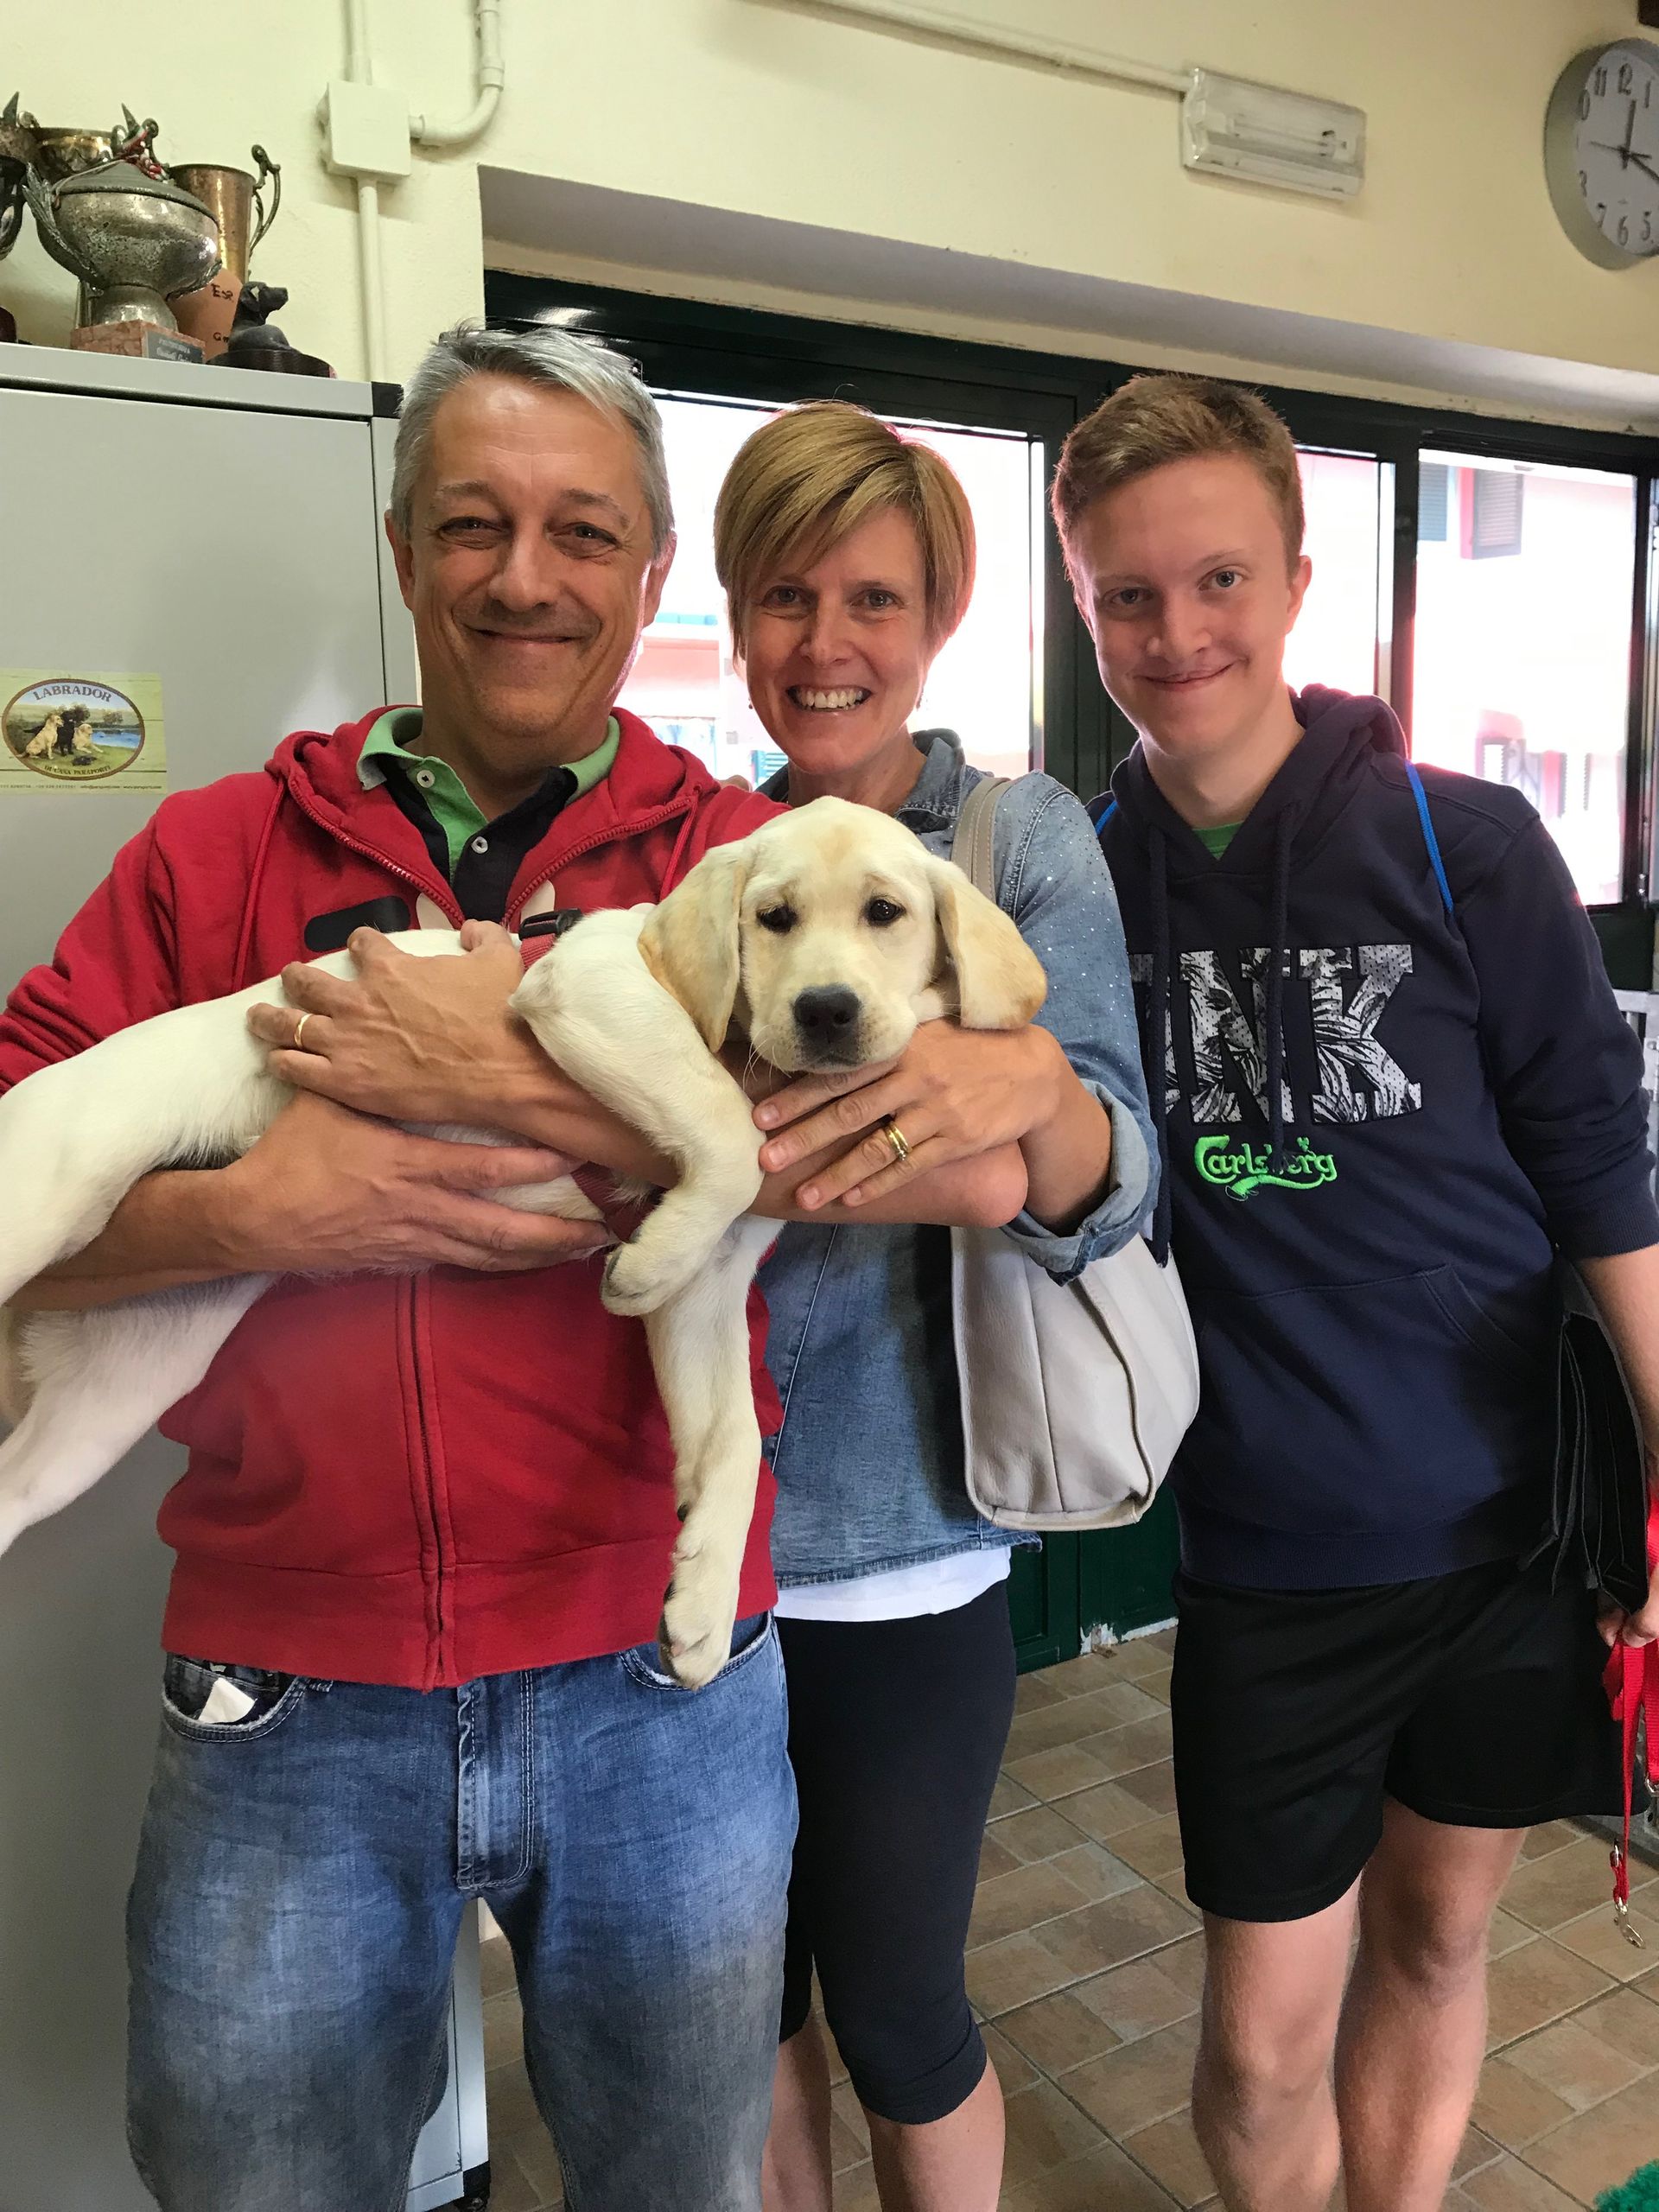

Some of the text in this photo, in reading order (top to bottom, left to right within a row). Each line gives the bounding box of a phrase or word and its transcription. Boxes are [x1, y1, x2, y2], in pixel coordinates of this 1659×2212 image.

[1593, 67, 1608, 97] 11
[1617, 215, 1630, 247] 6
[32, 684, 112, 703] LABRADOR
